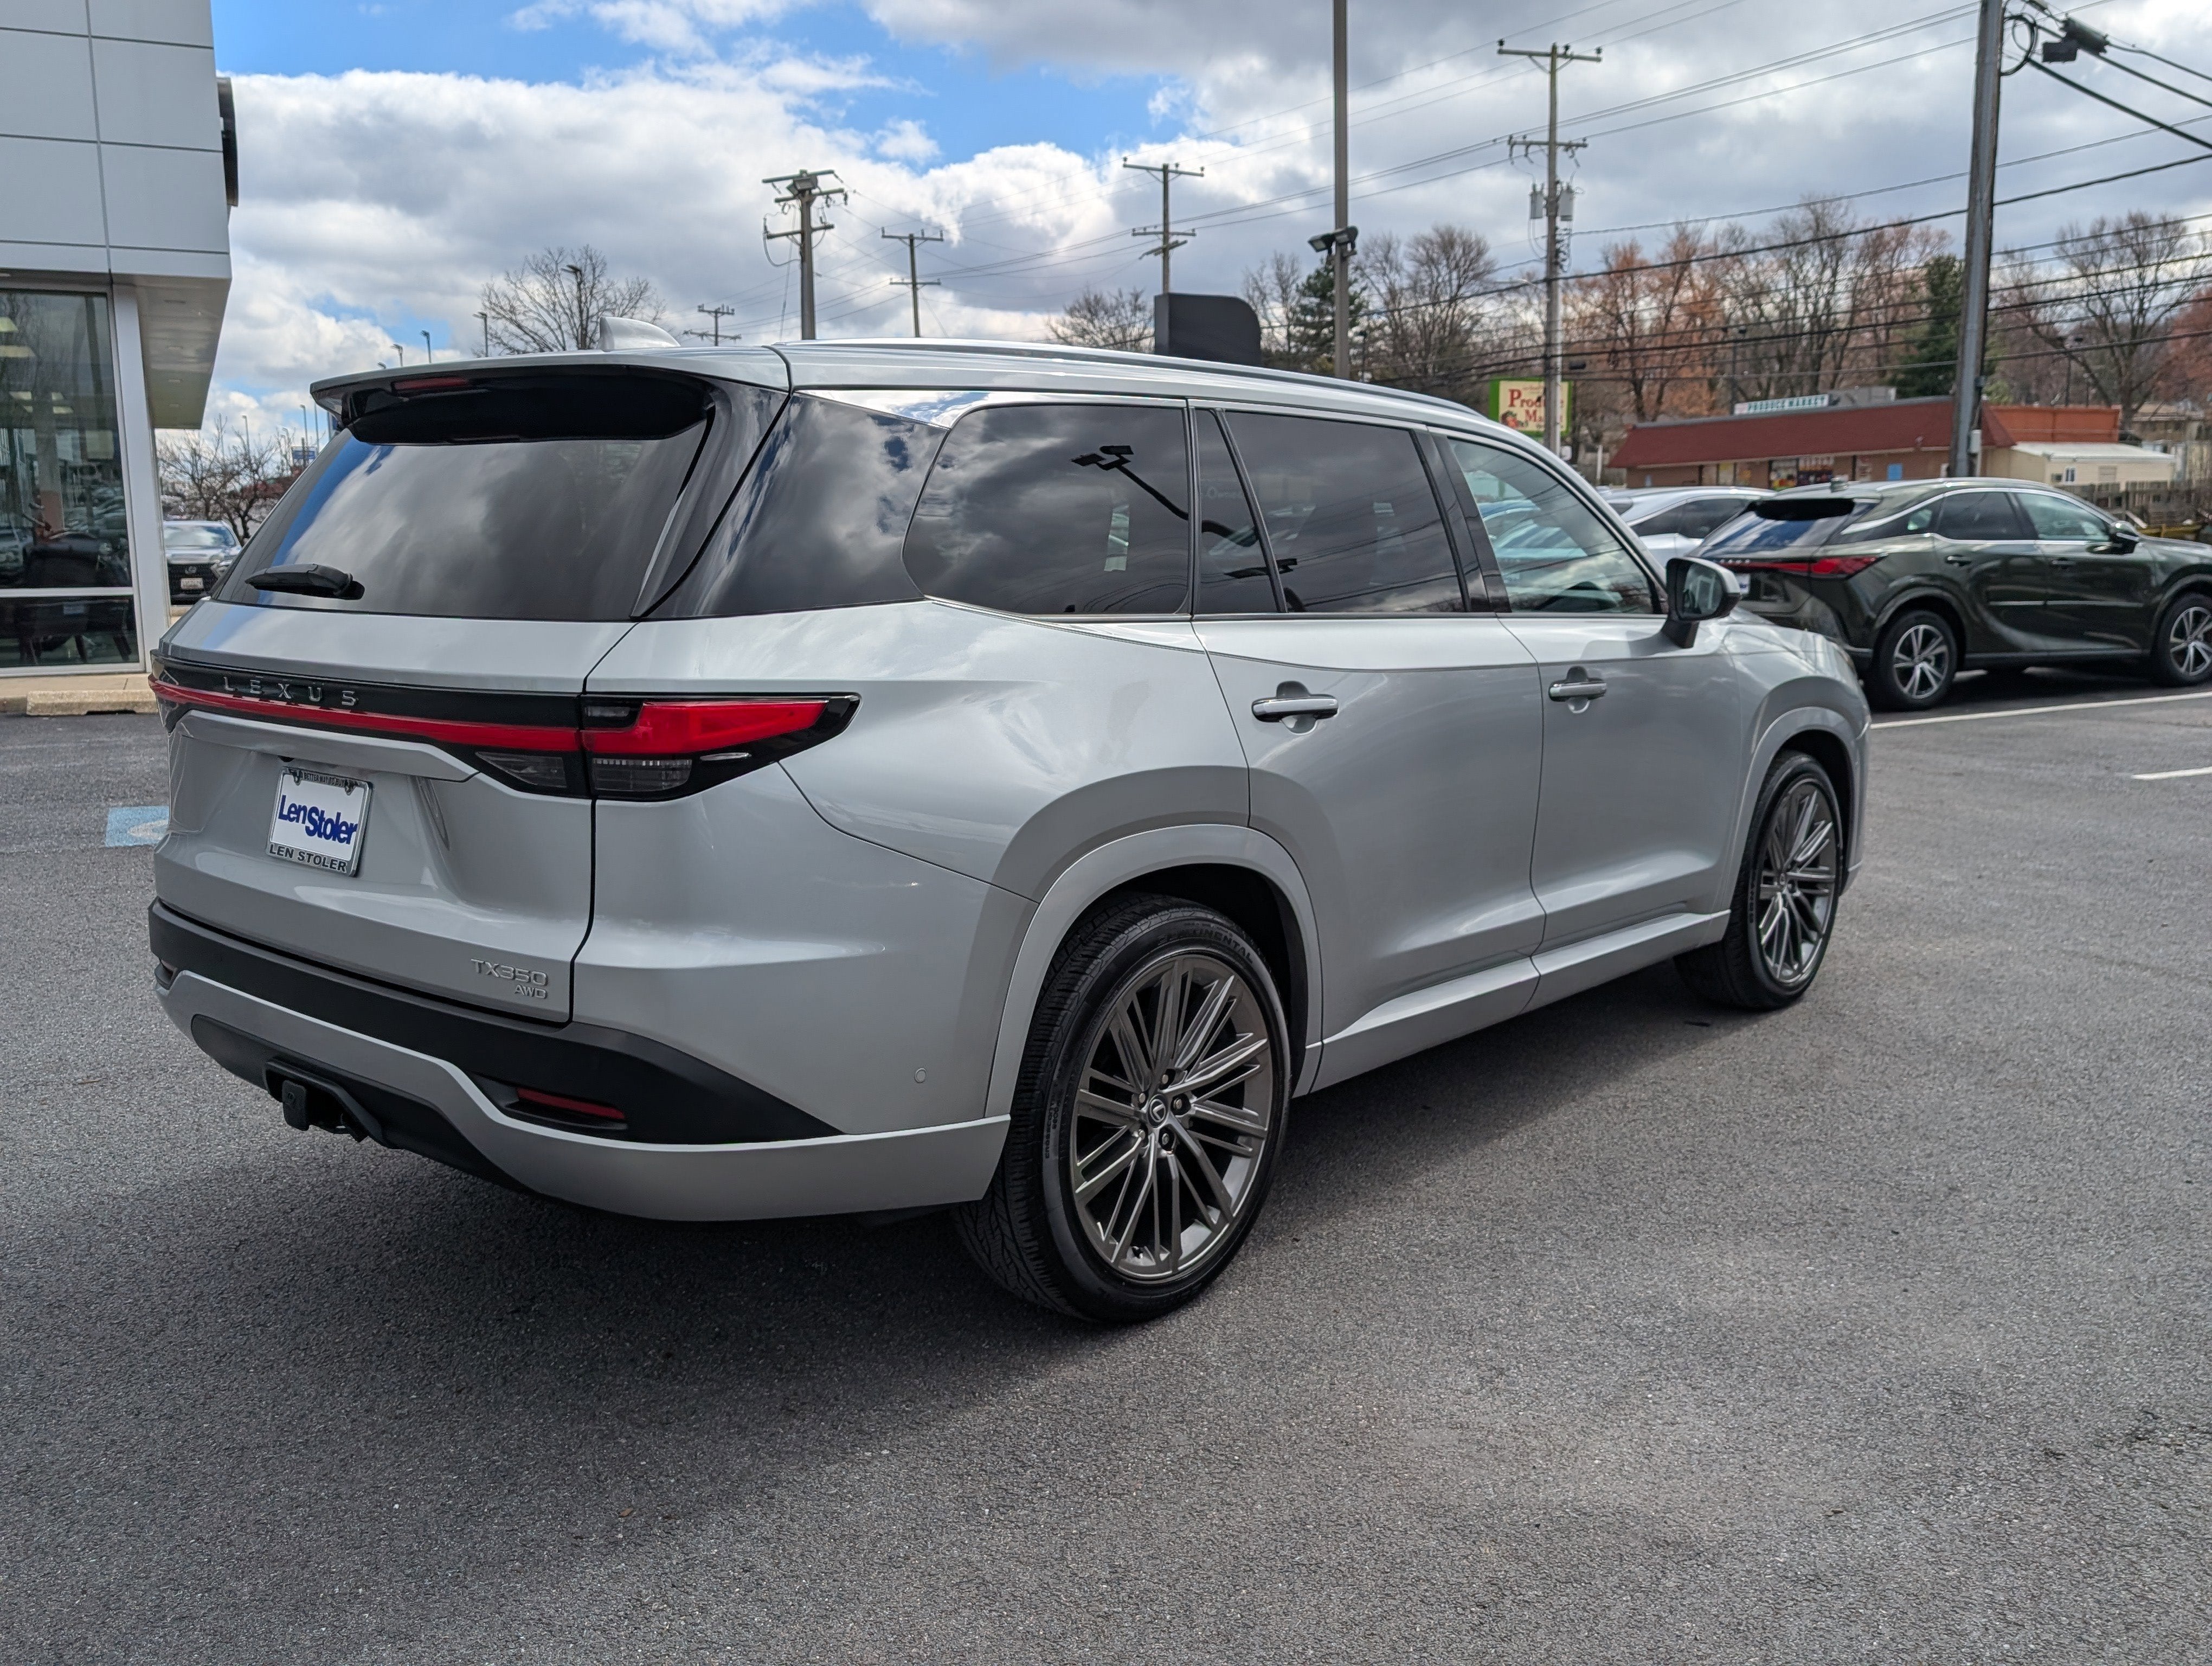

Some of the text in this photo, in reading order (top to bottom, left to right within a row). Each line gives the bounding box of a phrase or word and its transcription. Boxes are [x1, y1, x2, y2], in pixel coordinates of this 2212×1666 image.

[223, 677, 359, 706] LEXUS
[304, 772, 320, 782] BETTER
[269, 844, 347, 872] LEN STOLER
[471, 958, 548, 986] TX350
[515, 984, 548, 999] AWD
